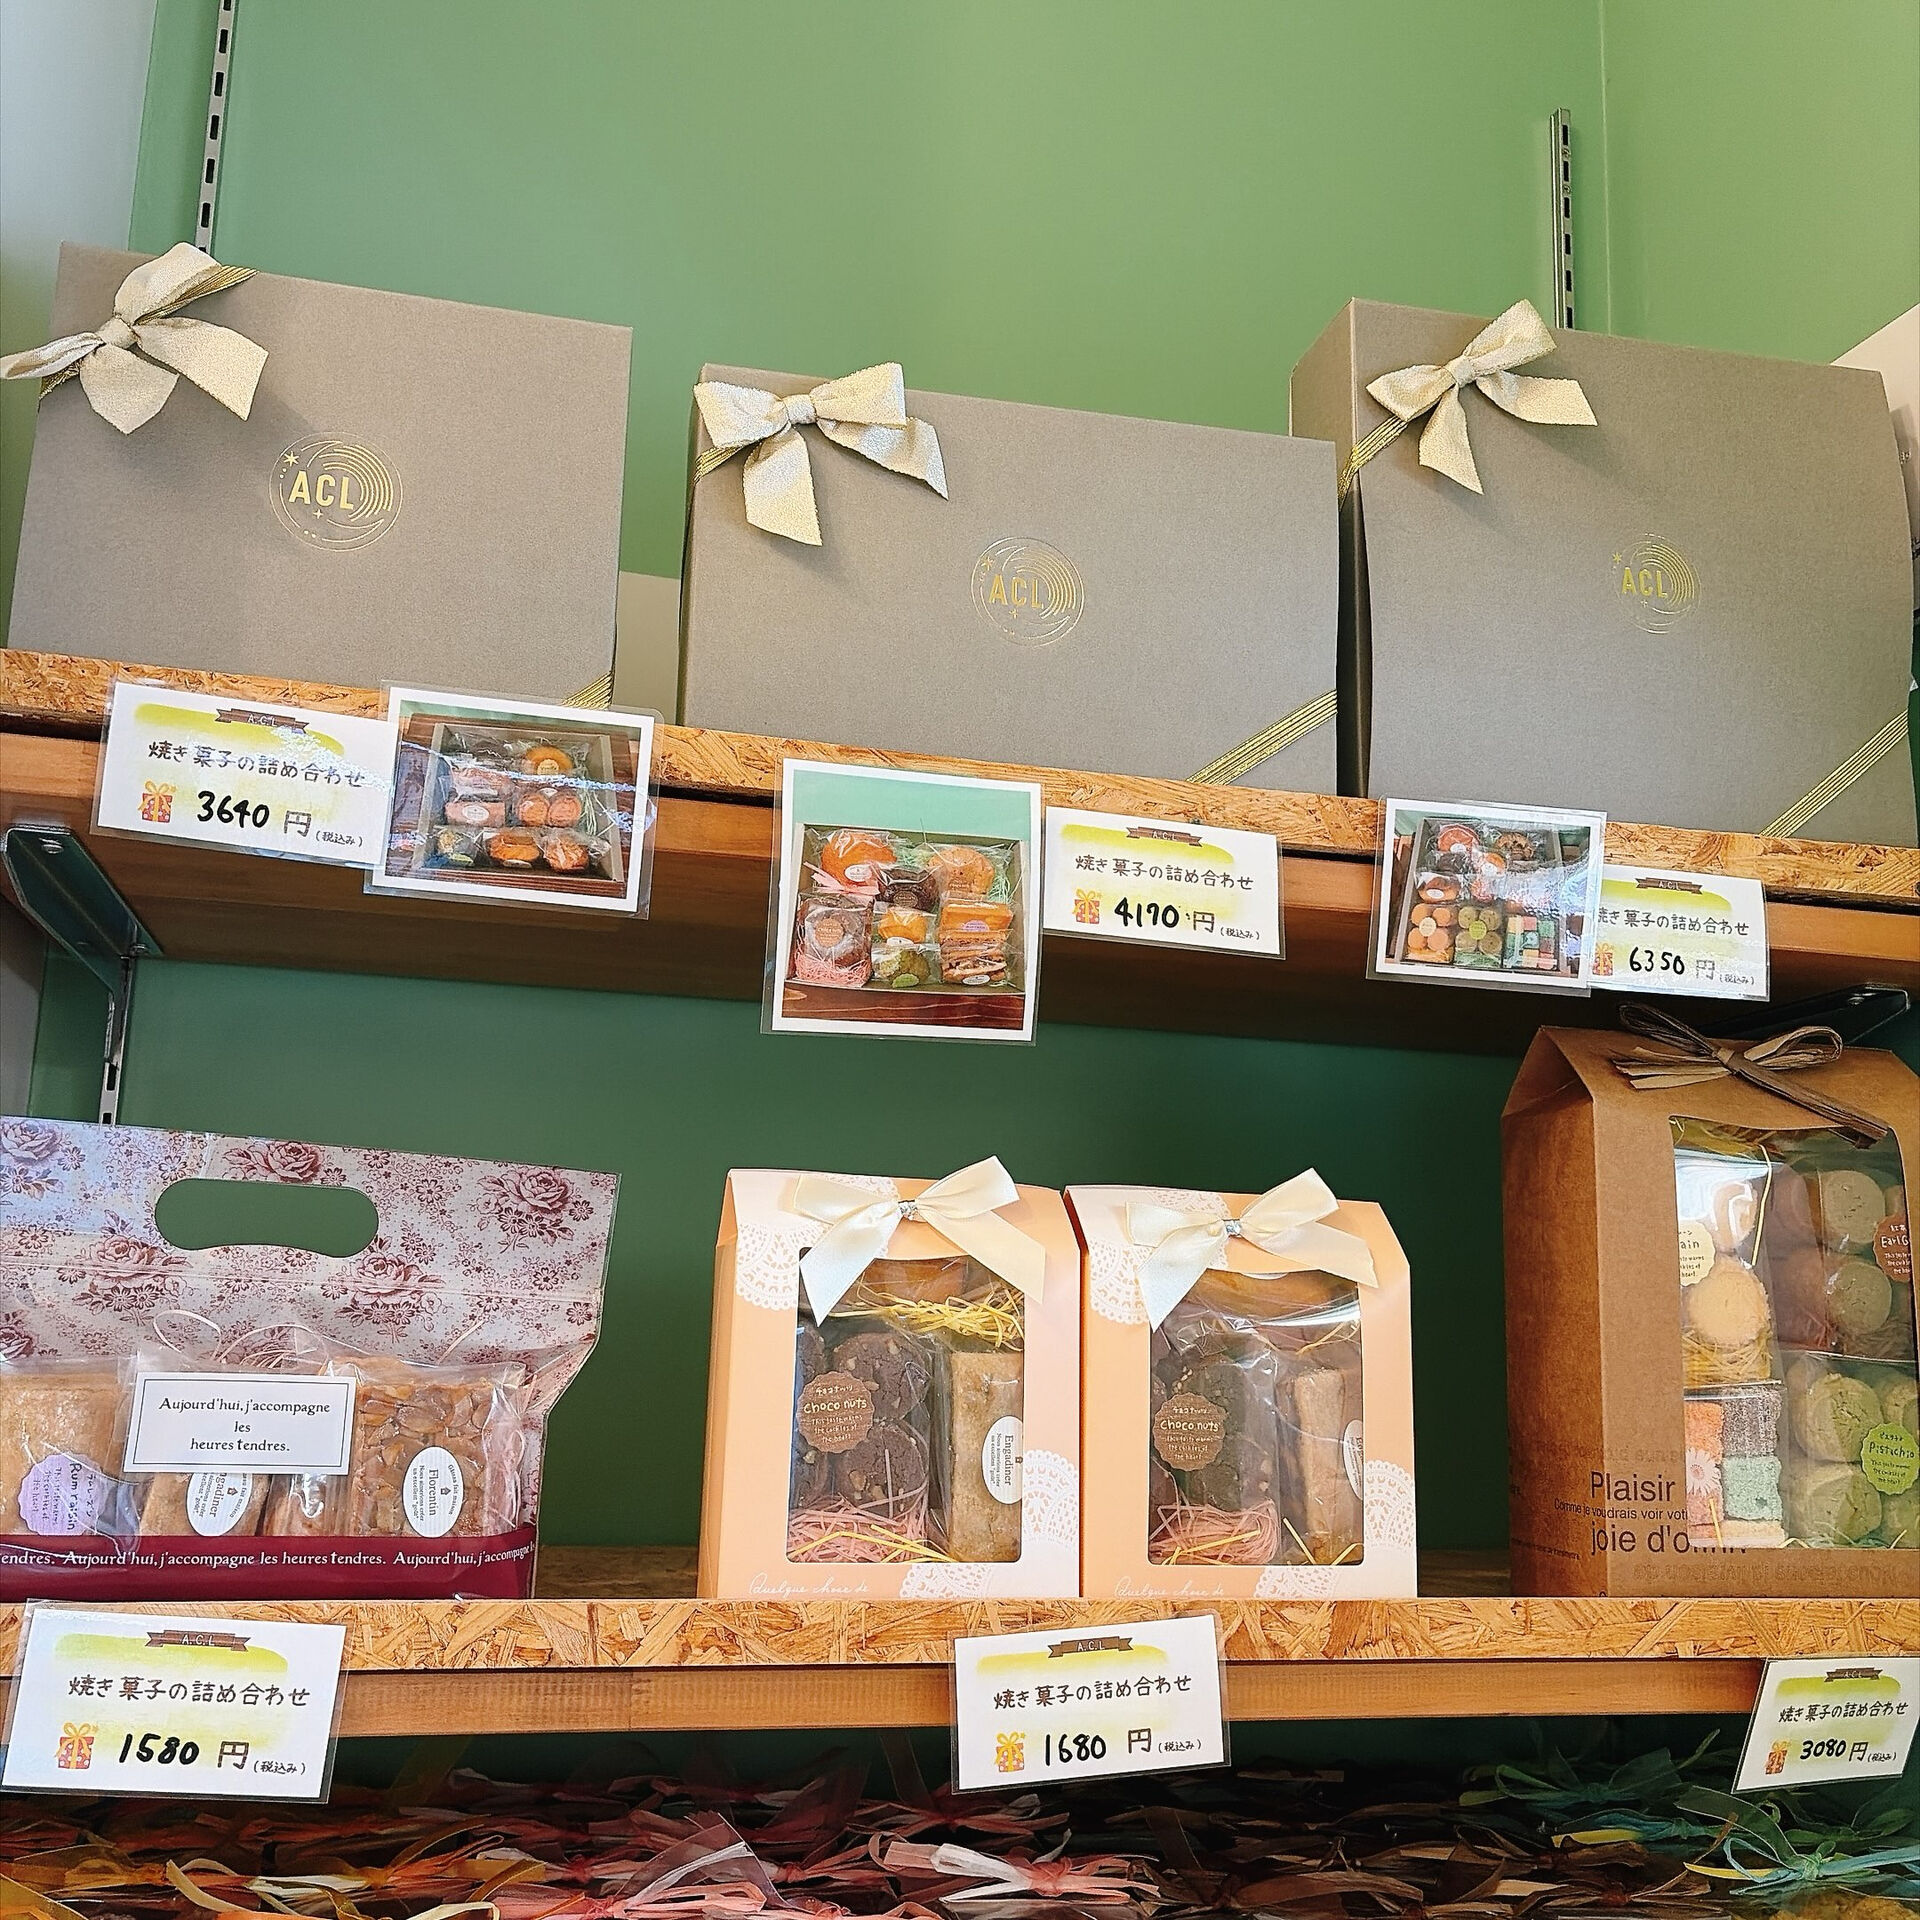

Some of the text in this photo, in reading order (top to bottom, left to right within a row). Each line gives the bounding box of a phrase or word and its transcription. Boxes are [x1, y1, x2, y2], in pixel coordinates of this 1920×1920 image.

[288, 470, 354, 510] ACL
[988, 574, 1044, 609] ACL
[1621, 567, 1668, 598] ACL
[196, 790, 270, 828] 3640
[283, 810, 312, 837] 円
[1193, 910, 1216, 933] 円
[1629, 946, 1685, 976] 6350
[1680, 1240, 1700, 1249] ain
[1881, 1235, 1900, 1248] Earl
[843, 1398, 867, 1409] nuts
[234, 1421, 251, 1433] les
[190, 1437, 290, 1452] heures tendres.
[1003, 1435, 1014, 1486] Engadiner
[66, 1463, 82, 1531] Rum raisin
[209, 1473, 228, 1518] ngadiner
[429, 1469, 439, 1516] Florentin
[1591, 1471, 1676, 1501] Plaisir
[1554, 1498, 1582, 1514] Comme
[1592, 1506, 1637, 1519] voudrais
[1640, 1508, 1663, 1520] voir
[1591, 1521, 1636, 1556] joie
[0, 1552, 55, 1565] endres.
[259, 1551, 278, 1565] les
[281, 1552, 328, 1565] heures
[330, 1551, 386, 1565] tendres.
[119, 1733, 199, 1766] 1580
[217, 1740, 249, 1769] 円
[1044, 1733, 1107, 1766] 1680
[1128, 1728, 1151, 1754] 円
[1800, 1738, 1846, 1760] 3080
[1849, 1742, 1869, 1762] 円
